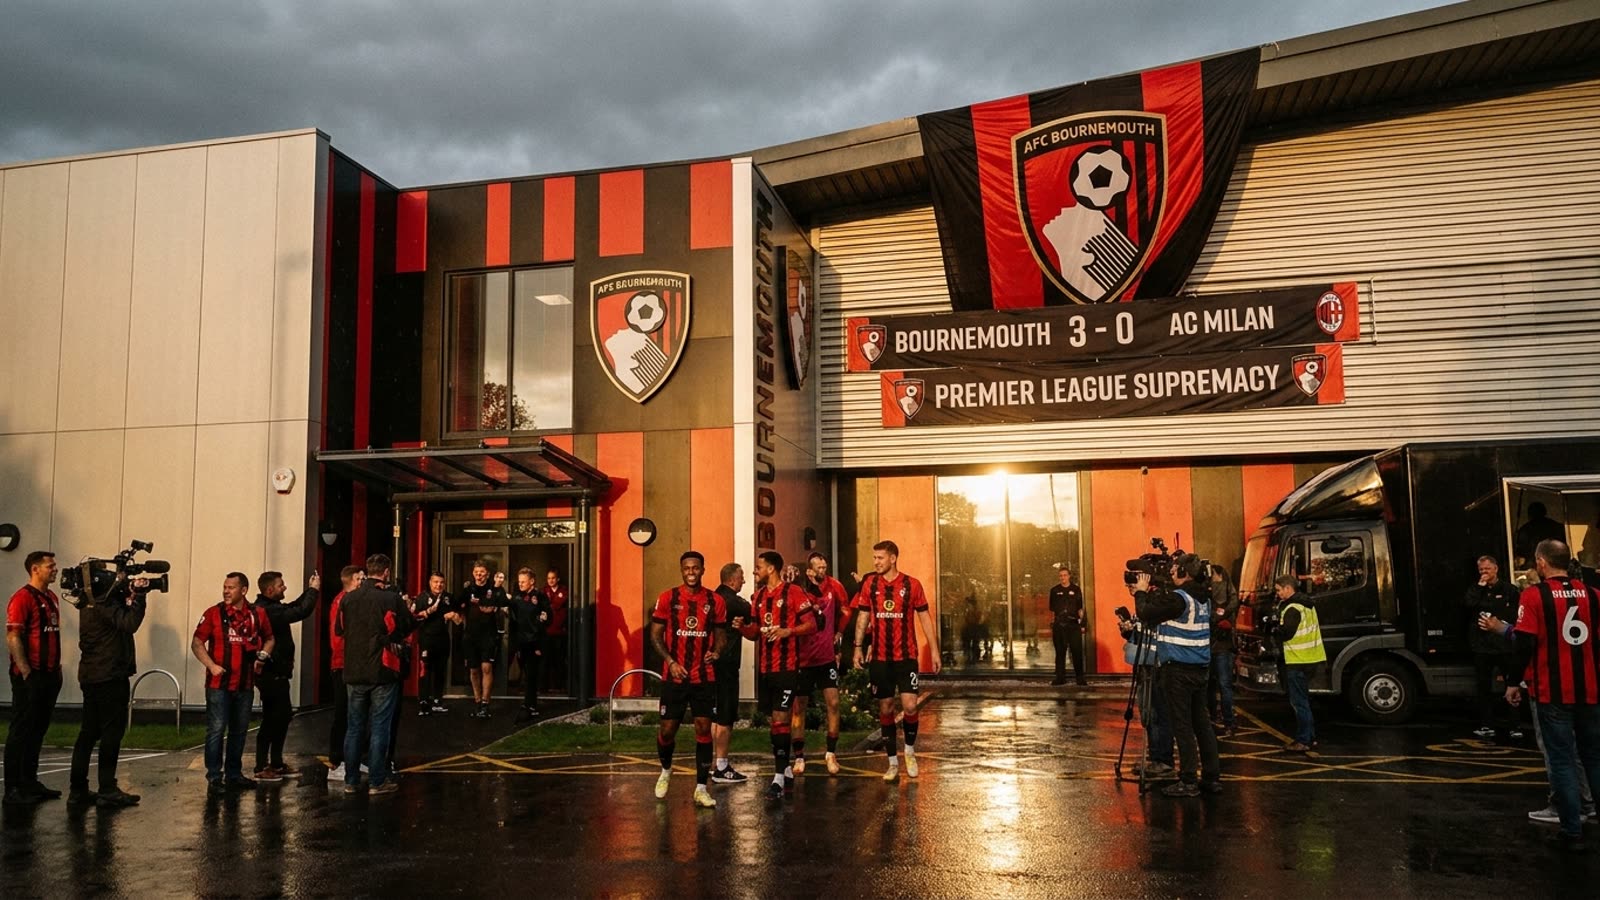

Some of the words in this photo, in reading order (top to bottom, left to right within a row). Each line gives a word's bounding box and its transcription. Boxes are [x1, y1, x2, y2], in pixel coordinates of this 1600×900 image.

[1023, 134, 1048, 154] AFC
[1051, 121, 1155, 144] BOURNEMOUTH
[895, 321, 1051, 354] BOURNEMOUTH
[1068, 315, 1087, 348] 3
[1115, 311, 1134, 345] 0
[1169, 311, 1198, 336] AC
[1203, 305, 1274, 334] MILAN
[755, 187, 775, 550] BOURNEMOUTH
[935, 379, 1035, 409] PREMIER
[1041, 374, 1128, 405] LEAGUE
[1133, 364, 1280, 400] SUPREMACY
[1562, 605, 1589, 646] 6
